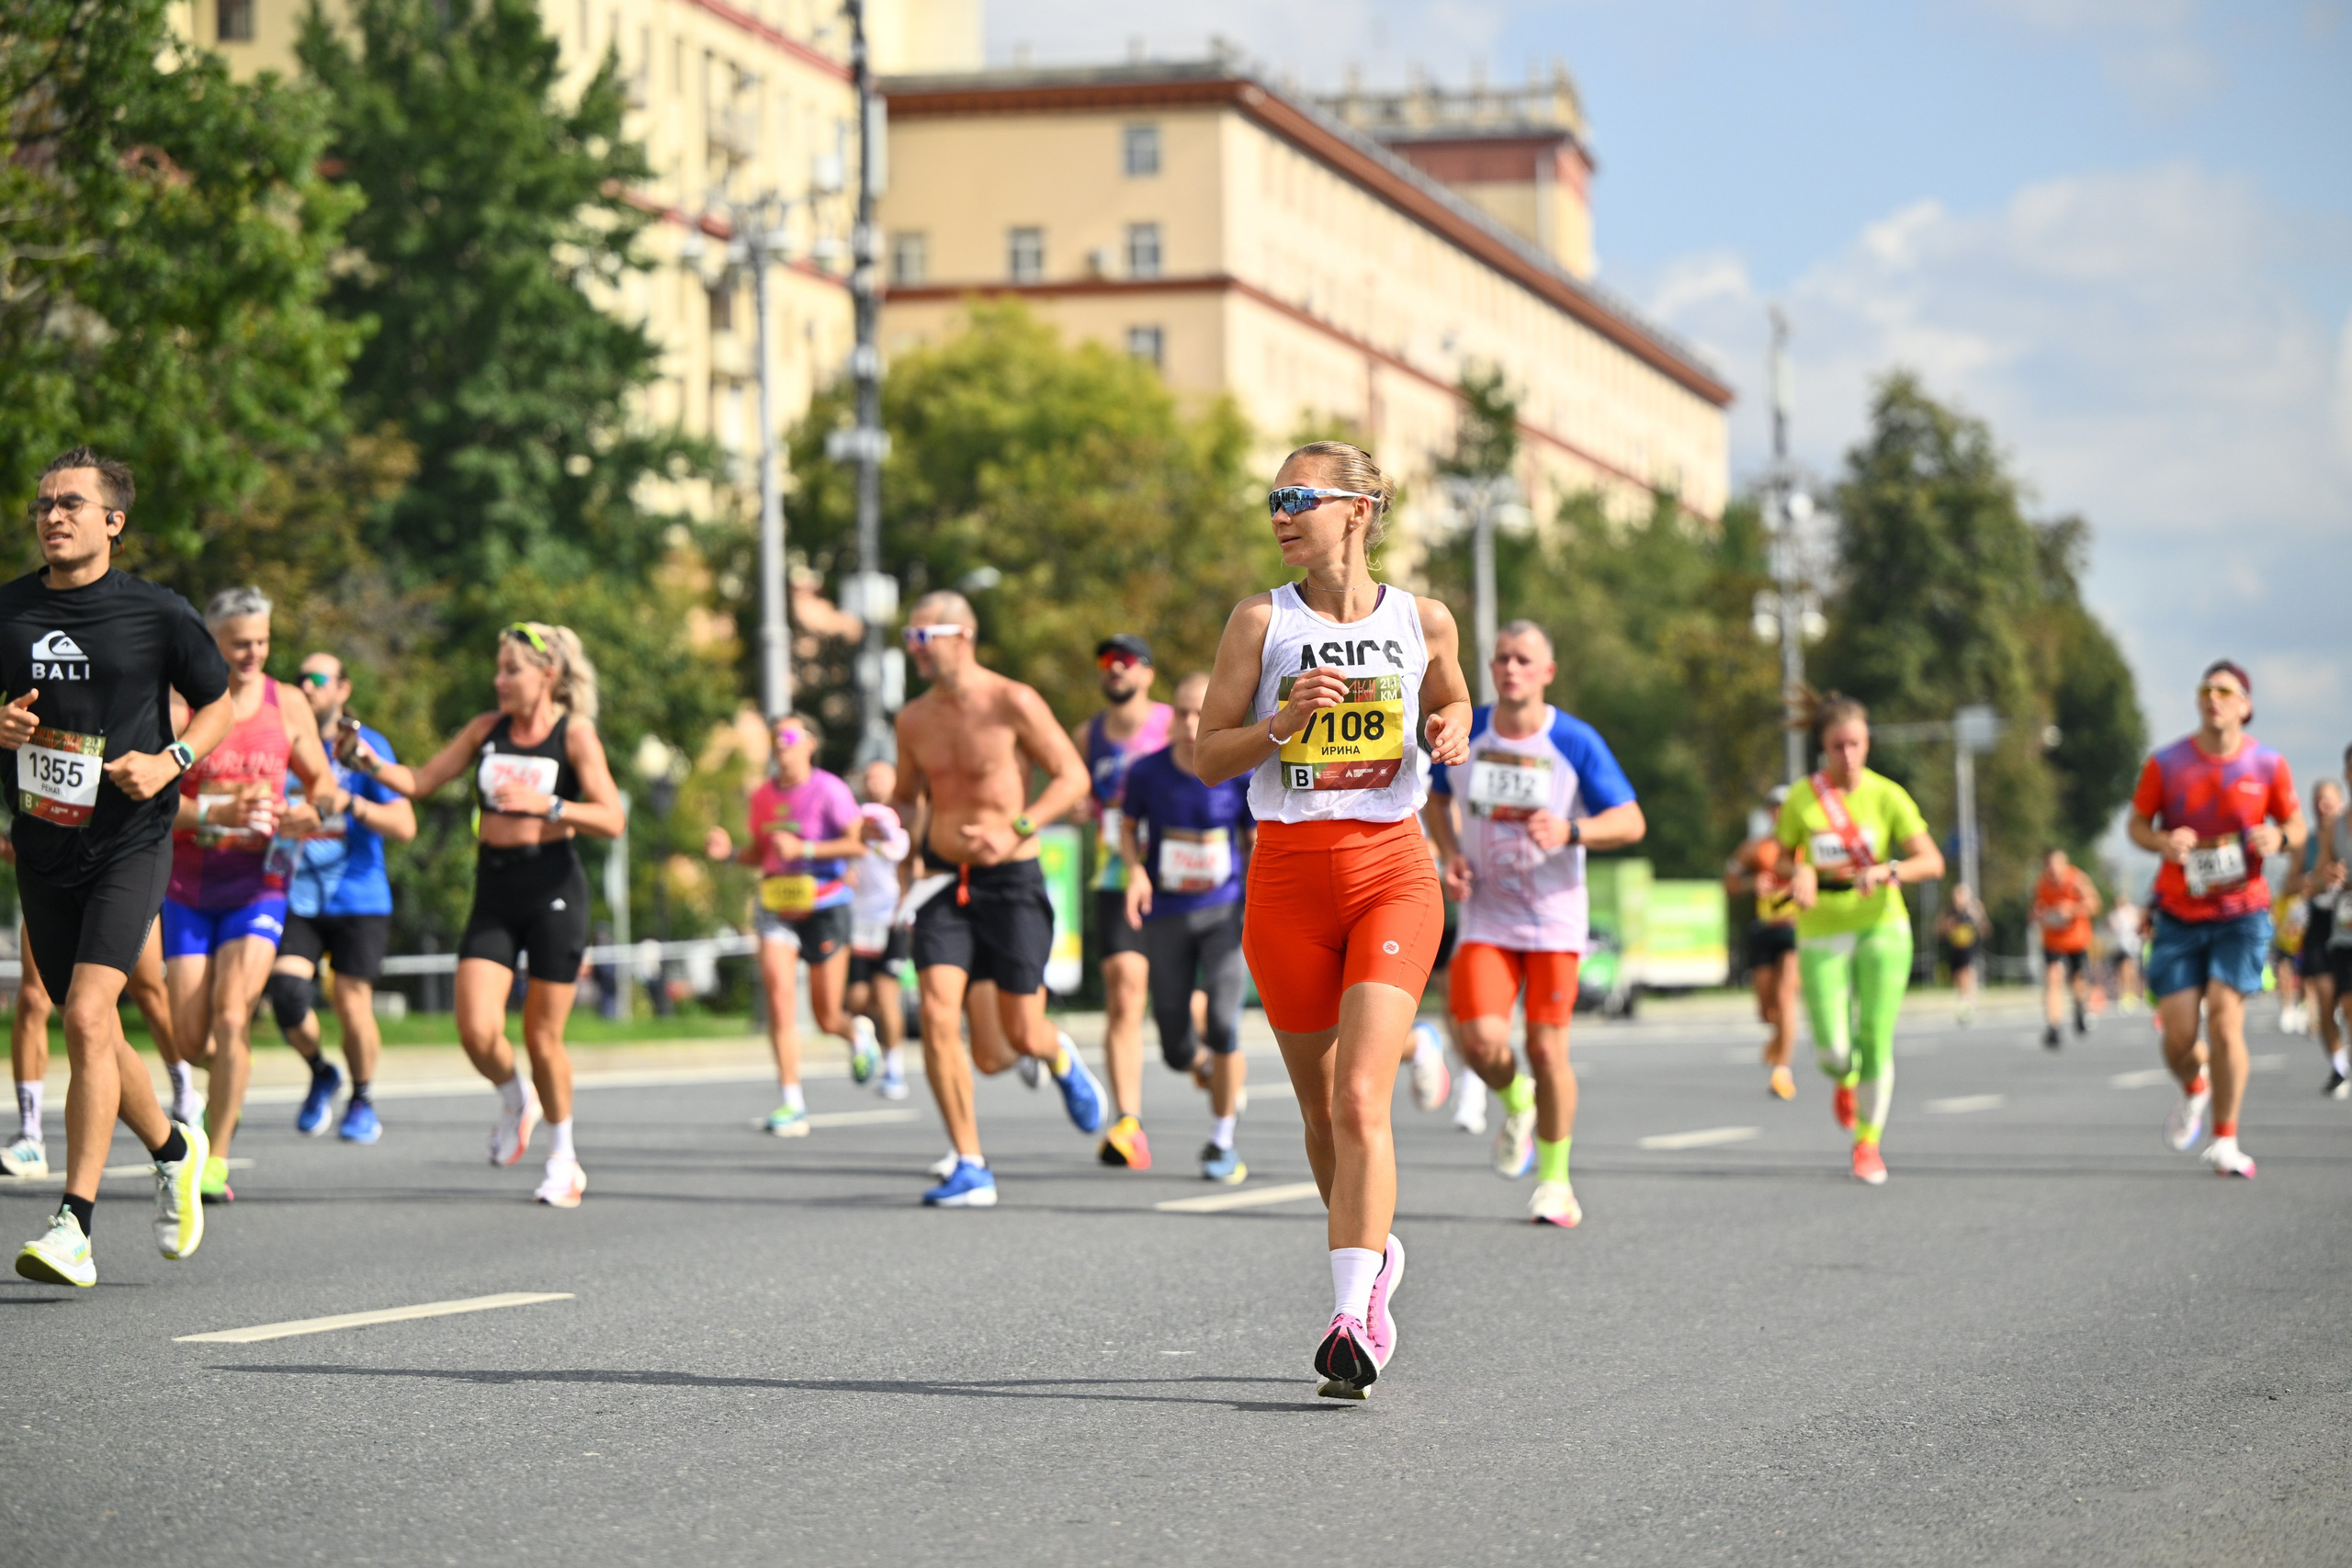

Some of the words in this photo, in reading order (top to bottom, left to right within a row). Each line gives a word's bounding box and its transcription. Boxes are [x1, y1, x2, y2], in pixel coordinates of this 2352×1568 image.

[32, 662, 90, 680] BALI
[1321, 745, 1361, 756] ИРИНА
[29, 751, 85, 787] 1355
[41, 782, 61, 795] РЕНАТ
